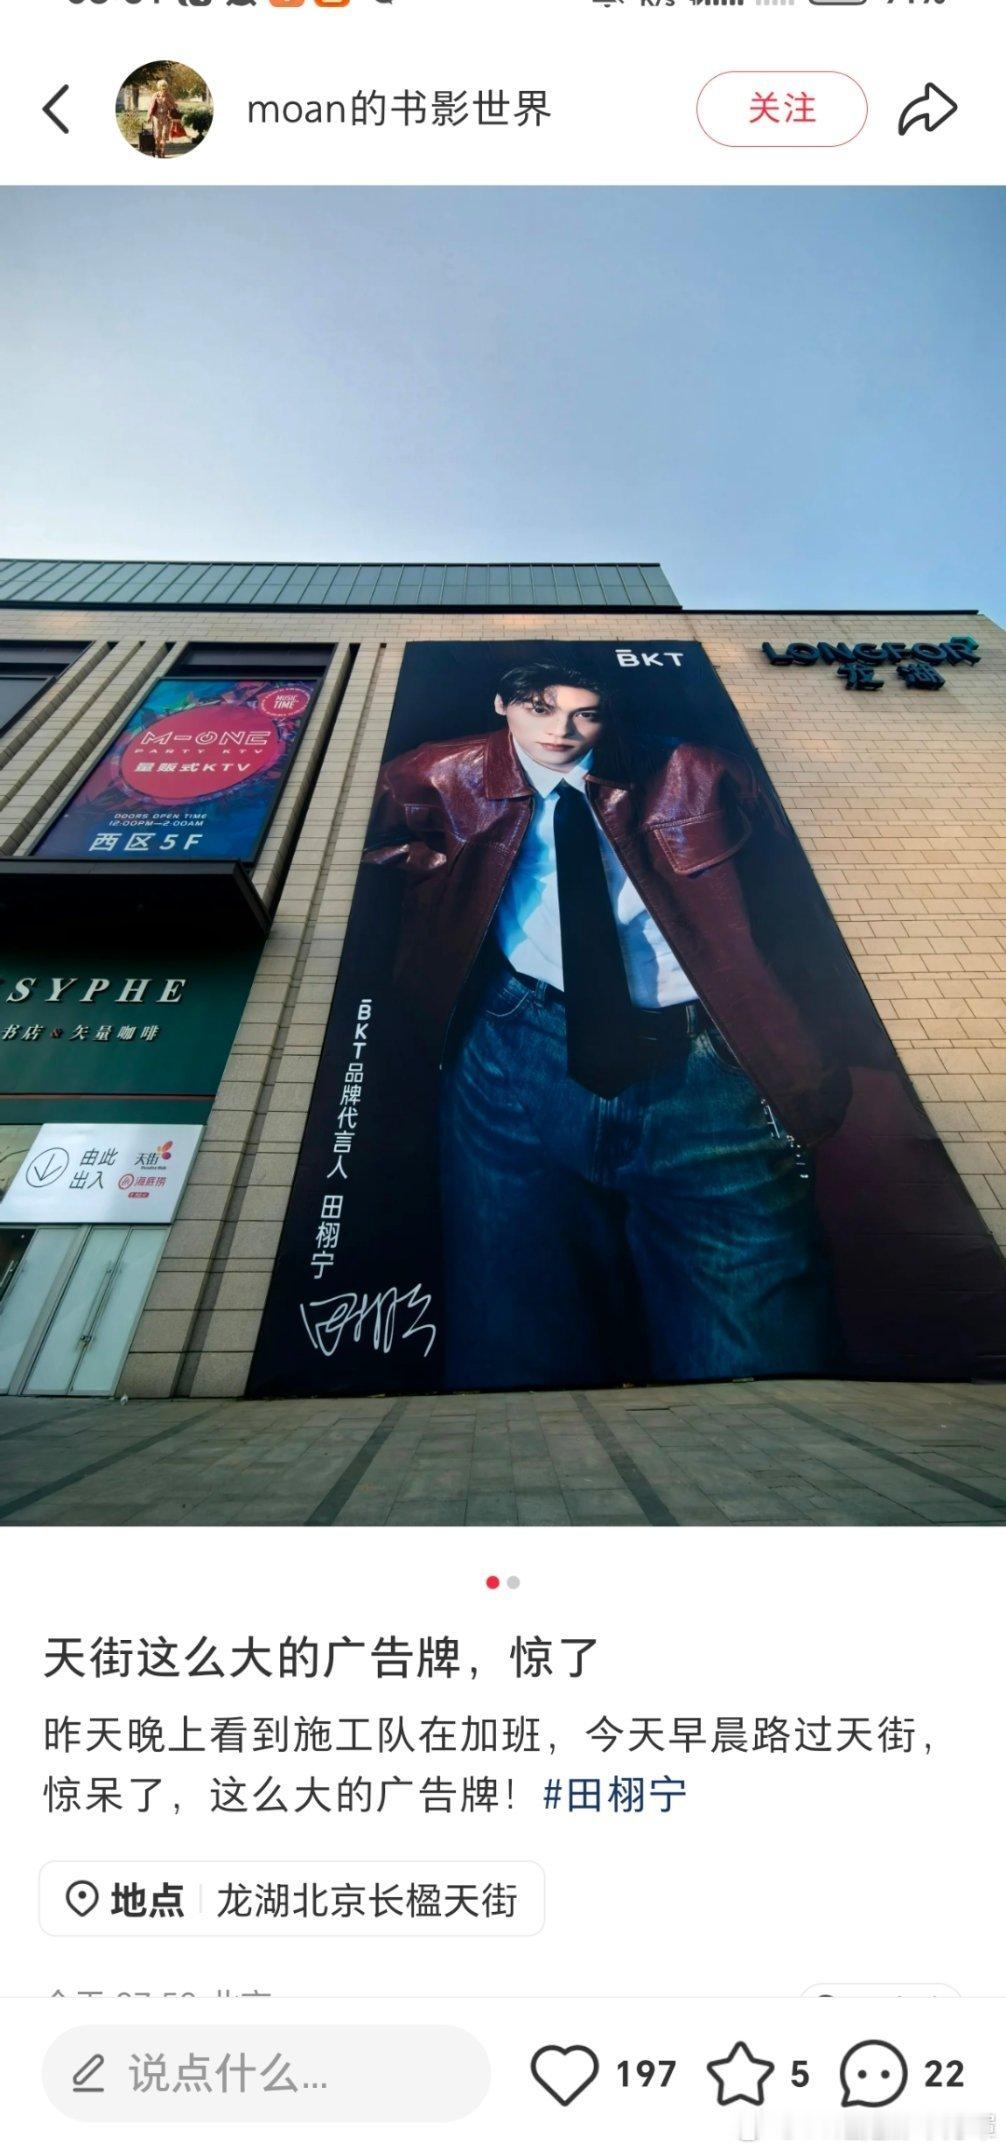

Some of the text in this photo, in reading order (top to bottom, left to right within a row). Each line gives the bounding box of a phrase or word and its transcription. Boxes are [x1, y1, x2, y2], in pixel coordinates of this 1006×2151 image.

[615, 648, 684, 668] BKT
[762, 641, 981, 666] LONGFOR
[80, 1148, 118, 1166] 由此
[69, 1171, 104, 1190] 出入
[310, 1194, 343, 1280] 田栩宁
